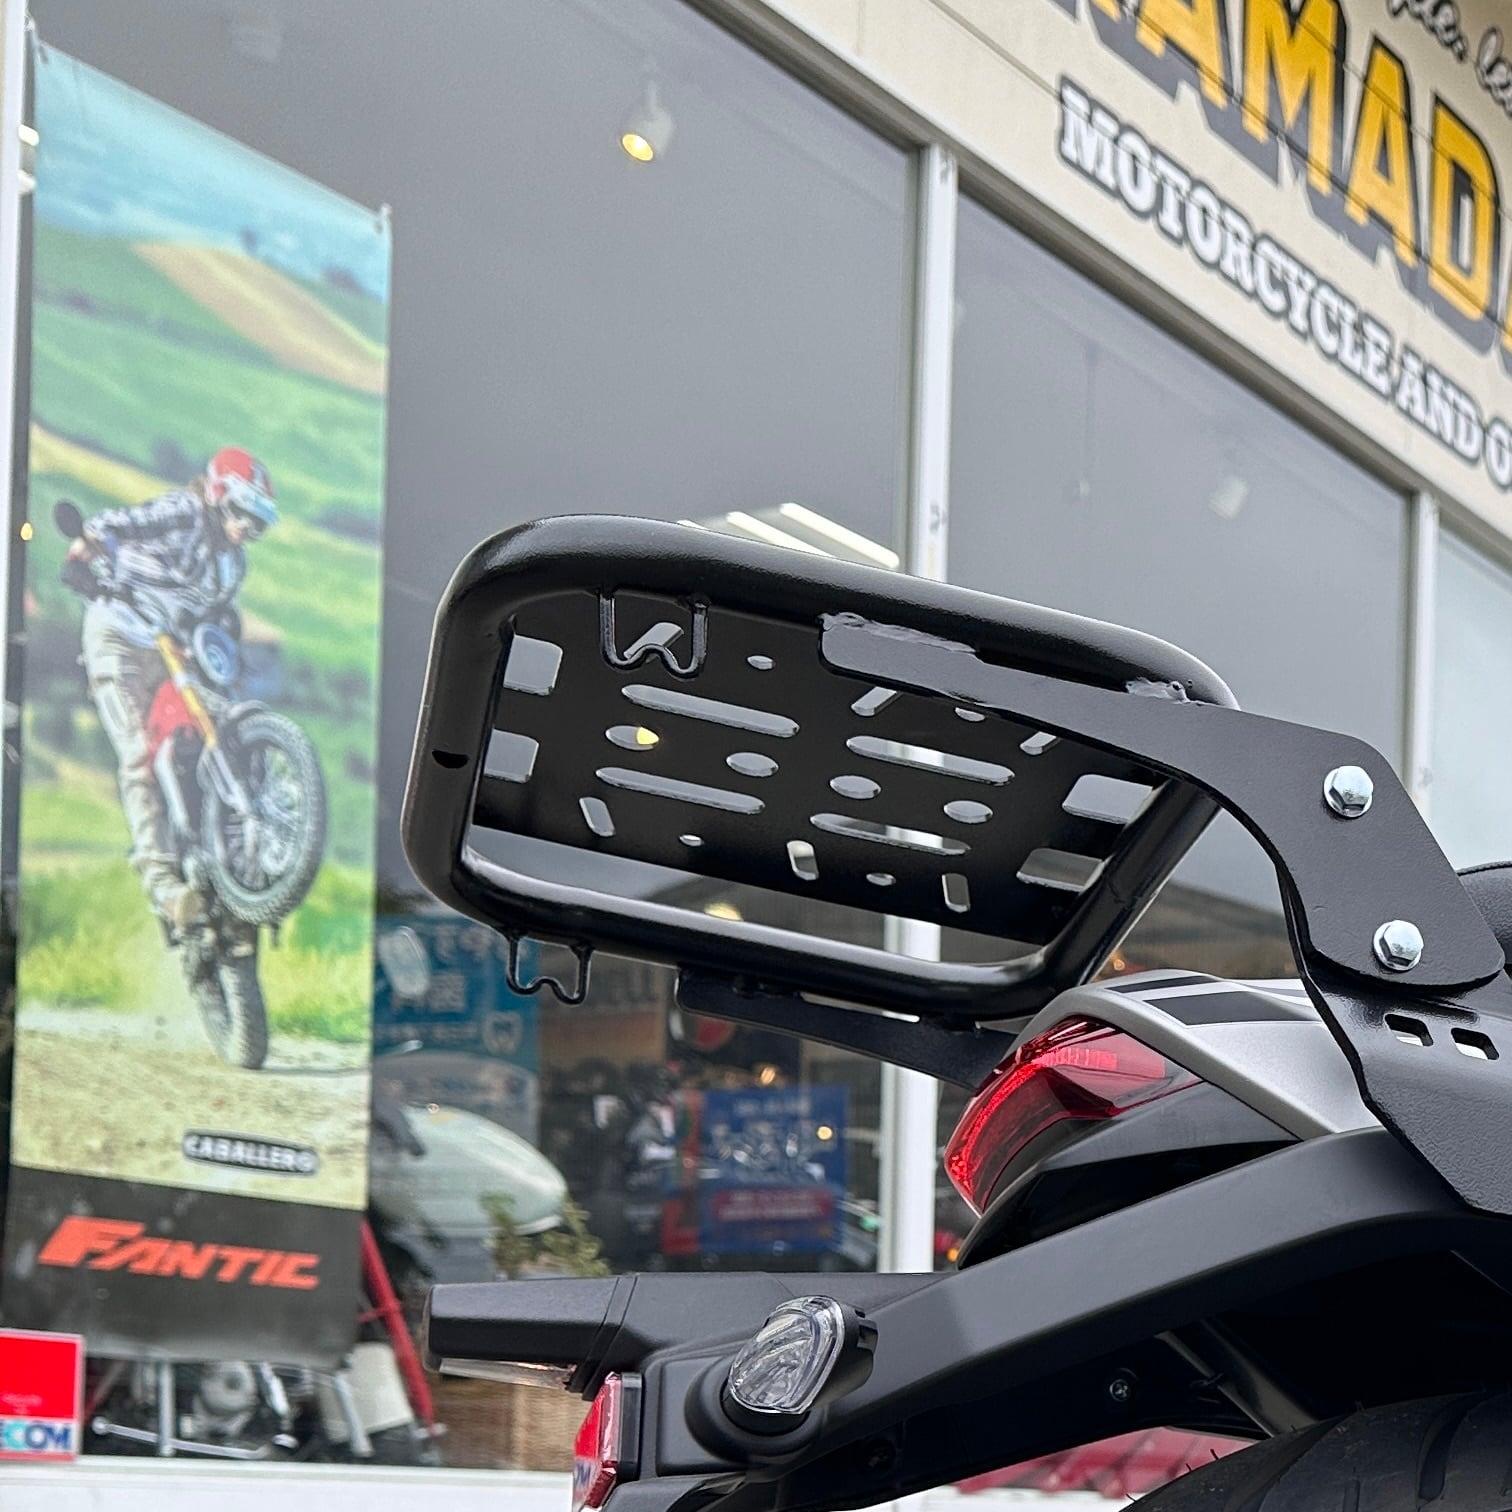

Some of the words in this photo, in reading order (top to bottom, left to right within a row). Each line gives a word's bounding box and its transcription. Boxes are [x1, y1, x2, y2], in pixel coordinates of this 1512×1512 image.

[1058, 76, 1392, 395] MOTORCYCLE
[1397, 346, 1483, 466] AND
[184, 1132, 317, 1174] CABALLERO
[39, 1215, 320, 1290] FANTIC
